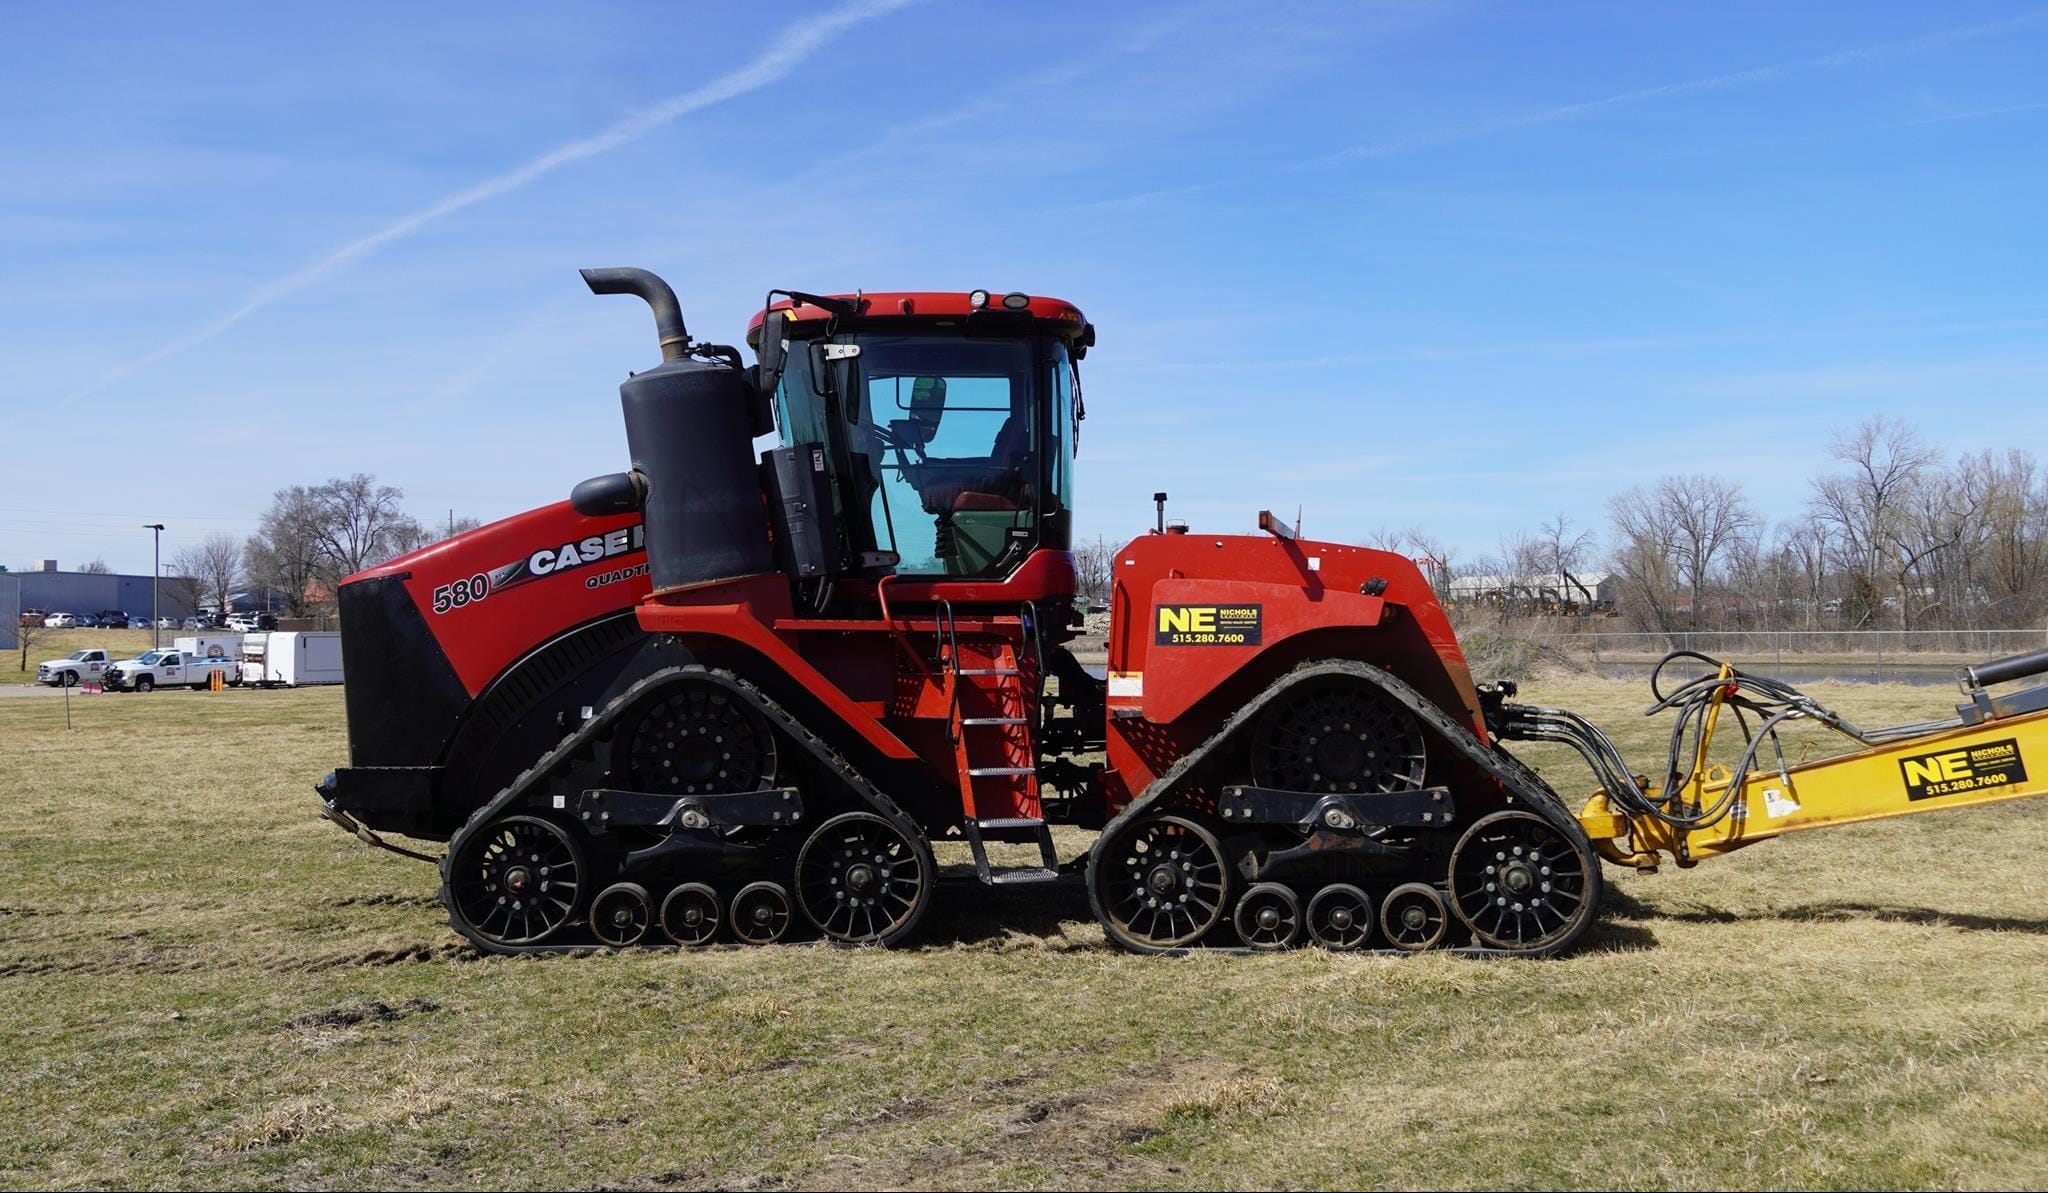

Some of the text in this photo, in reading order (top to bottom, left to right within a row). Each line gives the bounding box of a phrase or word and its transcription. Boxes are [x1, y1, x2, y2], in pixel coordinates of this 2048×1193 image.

[529, 529, 628, 575] CASE
[432, 573, 488, 615] 580
[1160, 608, 1217, 632] NE
[1172, 634, 1245, 643] 515.280.7600
[1971, 744, 2014, 757] NICHOLS
[1904, 751, 1973, 786] NE
[1926, 773, 2008, 796] 515.280.7600
